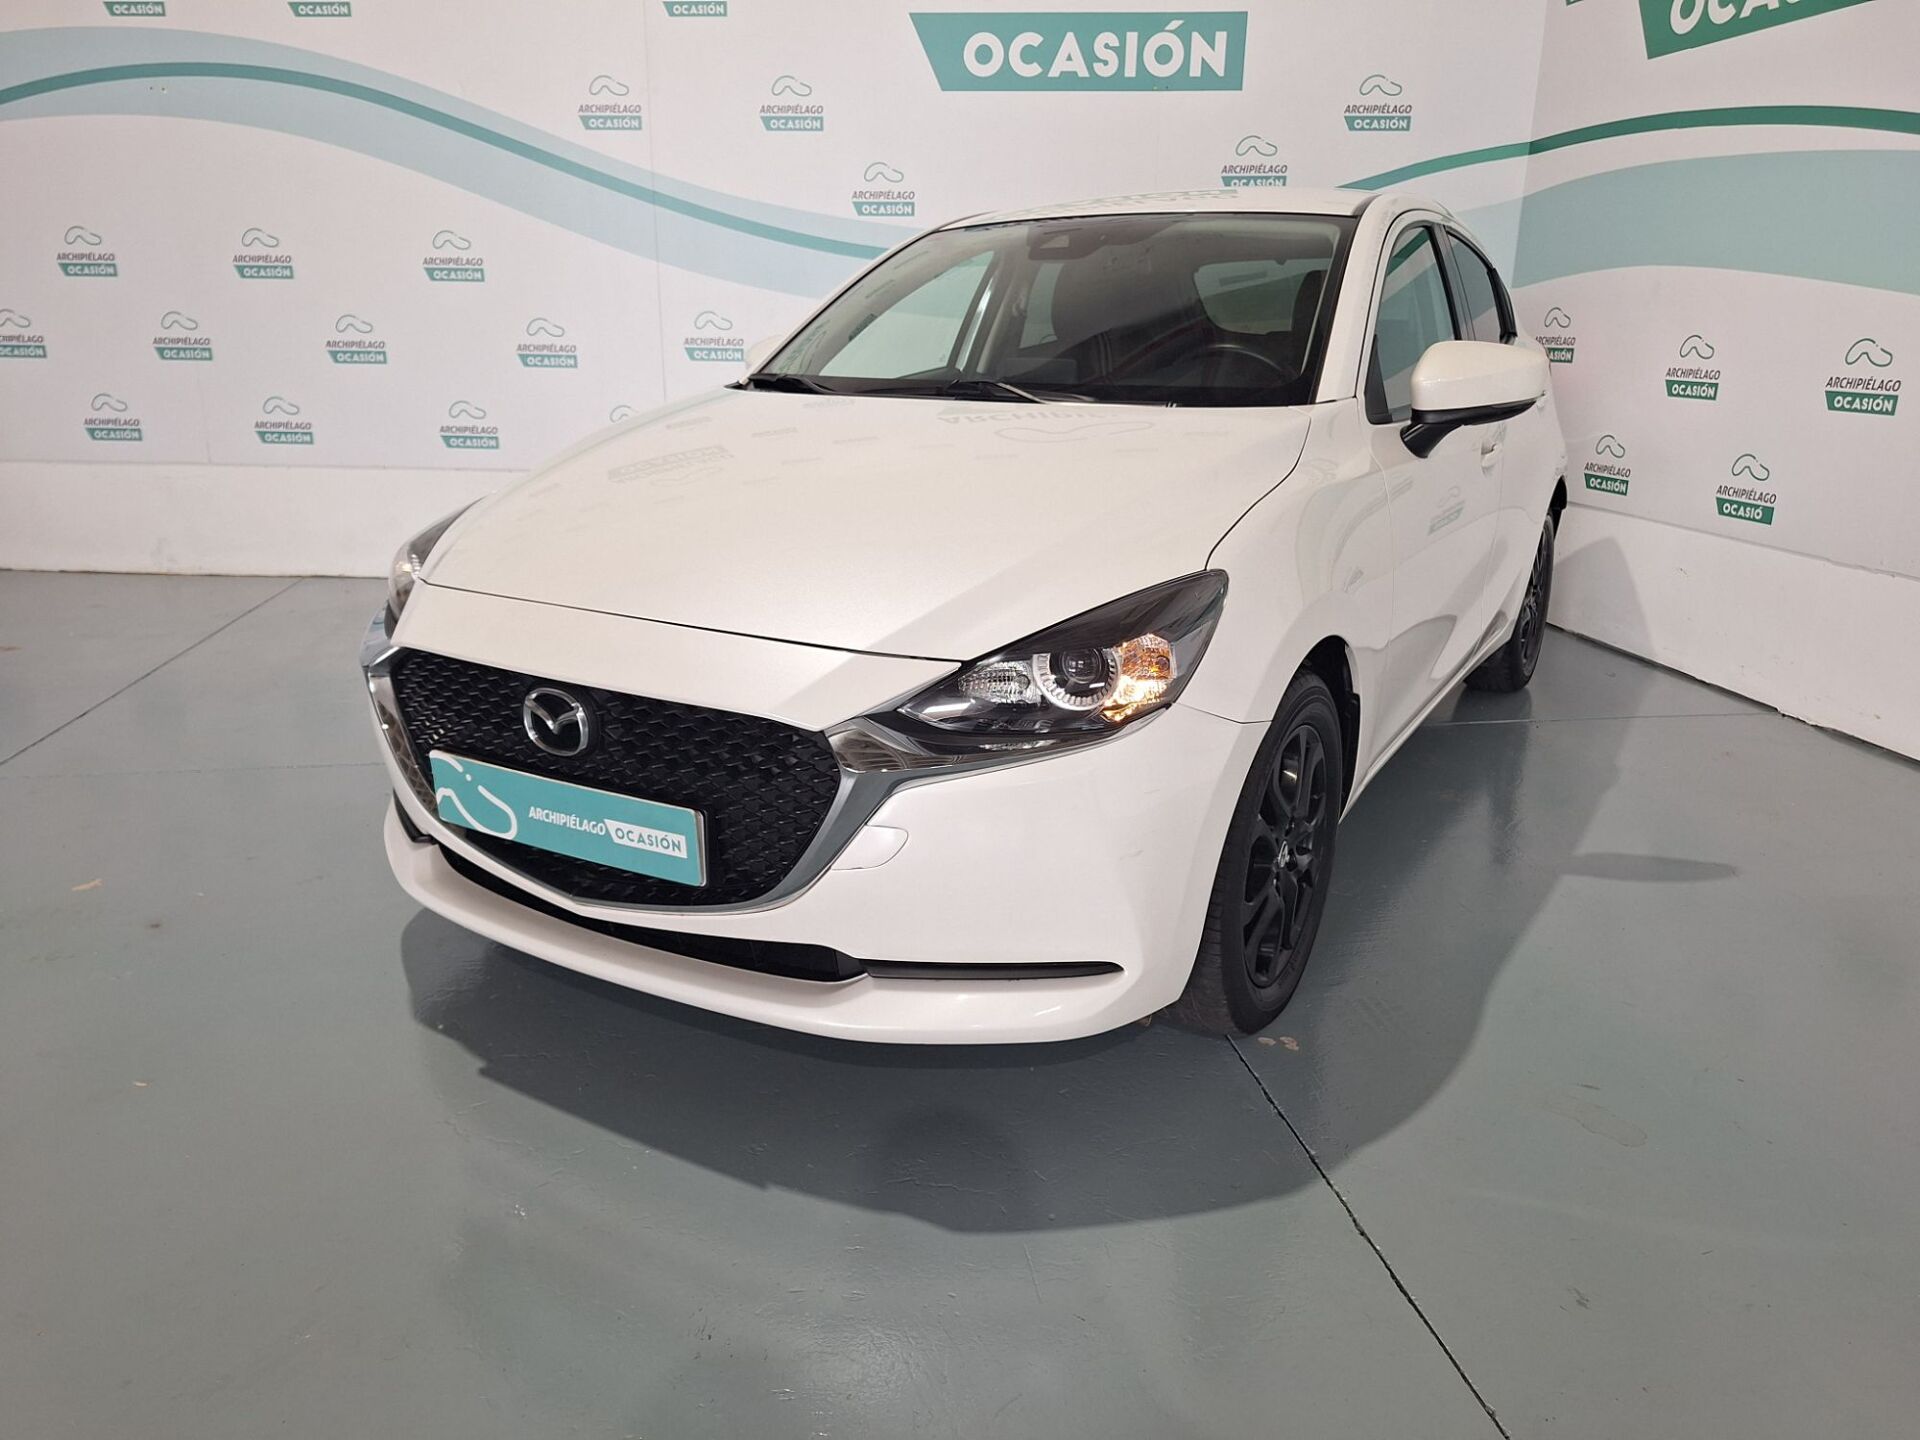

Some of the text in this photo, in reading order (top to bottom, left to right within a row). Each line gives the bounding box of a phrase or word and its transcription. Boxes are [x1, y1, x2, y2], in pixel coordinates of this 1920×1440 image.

[113, 2, 162, 15] OCASIÓN
[299, 2, 348, 15] OCASIÓN
[673, 2, 724, 14] OCASIÓN
[963, 20, 1227, 77] OCASIÓN
[579, 103, 640, 114] ARCHIPIÉLAGO
[760, 103, 823, 115] ARCHIPIÉLAGO
[1345, 103, 1411, 115] ARCHIPIÉLAGO
[589, 116, 639, 129] OCASIÓN
[771, 117, 822, 130] OCASIÓN
[1353, 117, 1408, 130] OCASIÓN
[1222, 163, 1287, 175] ARCHIPIÉLAGO
[852, 190, 914, 201] ARCHIPIÉLAGO
[862, 202, 913, 216] OCASIÓN
[57, 252, 115, 261] ARCHIPIÉLAGO
[233, 254, 291, 264] ARCHIPIÉLAGO
[423, 256, 483, 266] ARCHIPIÉLAGO
[67, 264, 114, 276] OCASIÓN
[243, 266, 291, 278] OCASIÓN
[434, 269, 482, 281] OCASIÓN
[153, 336, 210, 346] ARCHIPIÉLAGO
[326, 339, 385, 349] ARCHIPIÉLAGO
[684, 337, 743, 346] ARCHIPIÉLAGO
[517, 343, 576, 353] ARCHIPIÉLAGO
[695, 349, 742, 359] OCASIÓN
[164, 349, 210, 360] OCASIÓN
[337, 352, 384, 363] OCASIÓN
[1548, 349, 1573, 362] ASIÓN
[527, 355, 574, 367] OCASIÓN
[1666, 368, 1720, 381] ARCHIPIÉLAGO
[1671, 383, 1716, 398] OCASIÓN
[1826, 376, 1901, 393] ARCHIPIÉLAGO
[1833, 395, 1895, 413] OCASIÓN
[84, 417, 140, 427] ARCHIPIÉLAGO
[254, 420, 311, 430] ARCHIPIÉLAGO
[94, 429, 140, 440] OCASIÓN
[440, 424, 498, 434] ARCHIPIÉLAGO
[265, 432, 311, 444] OCASIÓN
[450, 436, 497, 447] OCASIÓN
[1584, 462, 1630, 478] ARCHIPIÉLAGO
[1589, 476, 1627, 493] OCASIÓN
[1716, 485, 1776, 504] ARCHIPIÉLAGO
[1722, 502, 1762, 520] OCASIÓ
[529, 804, 682, 853] ARCHIPIÉLAGO OCASIÓN
